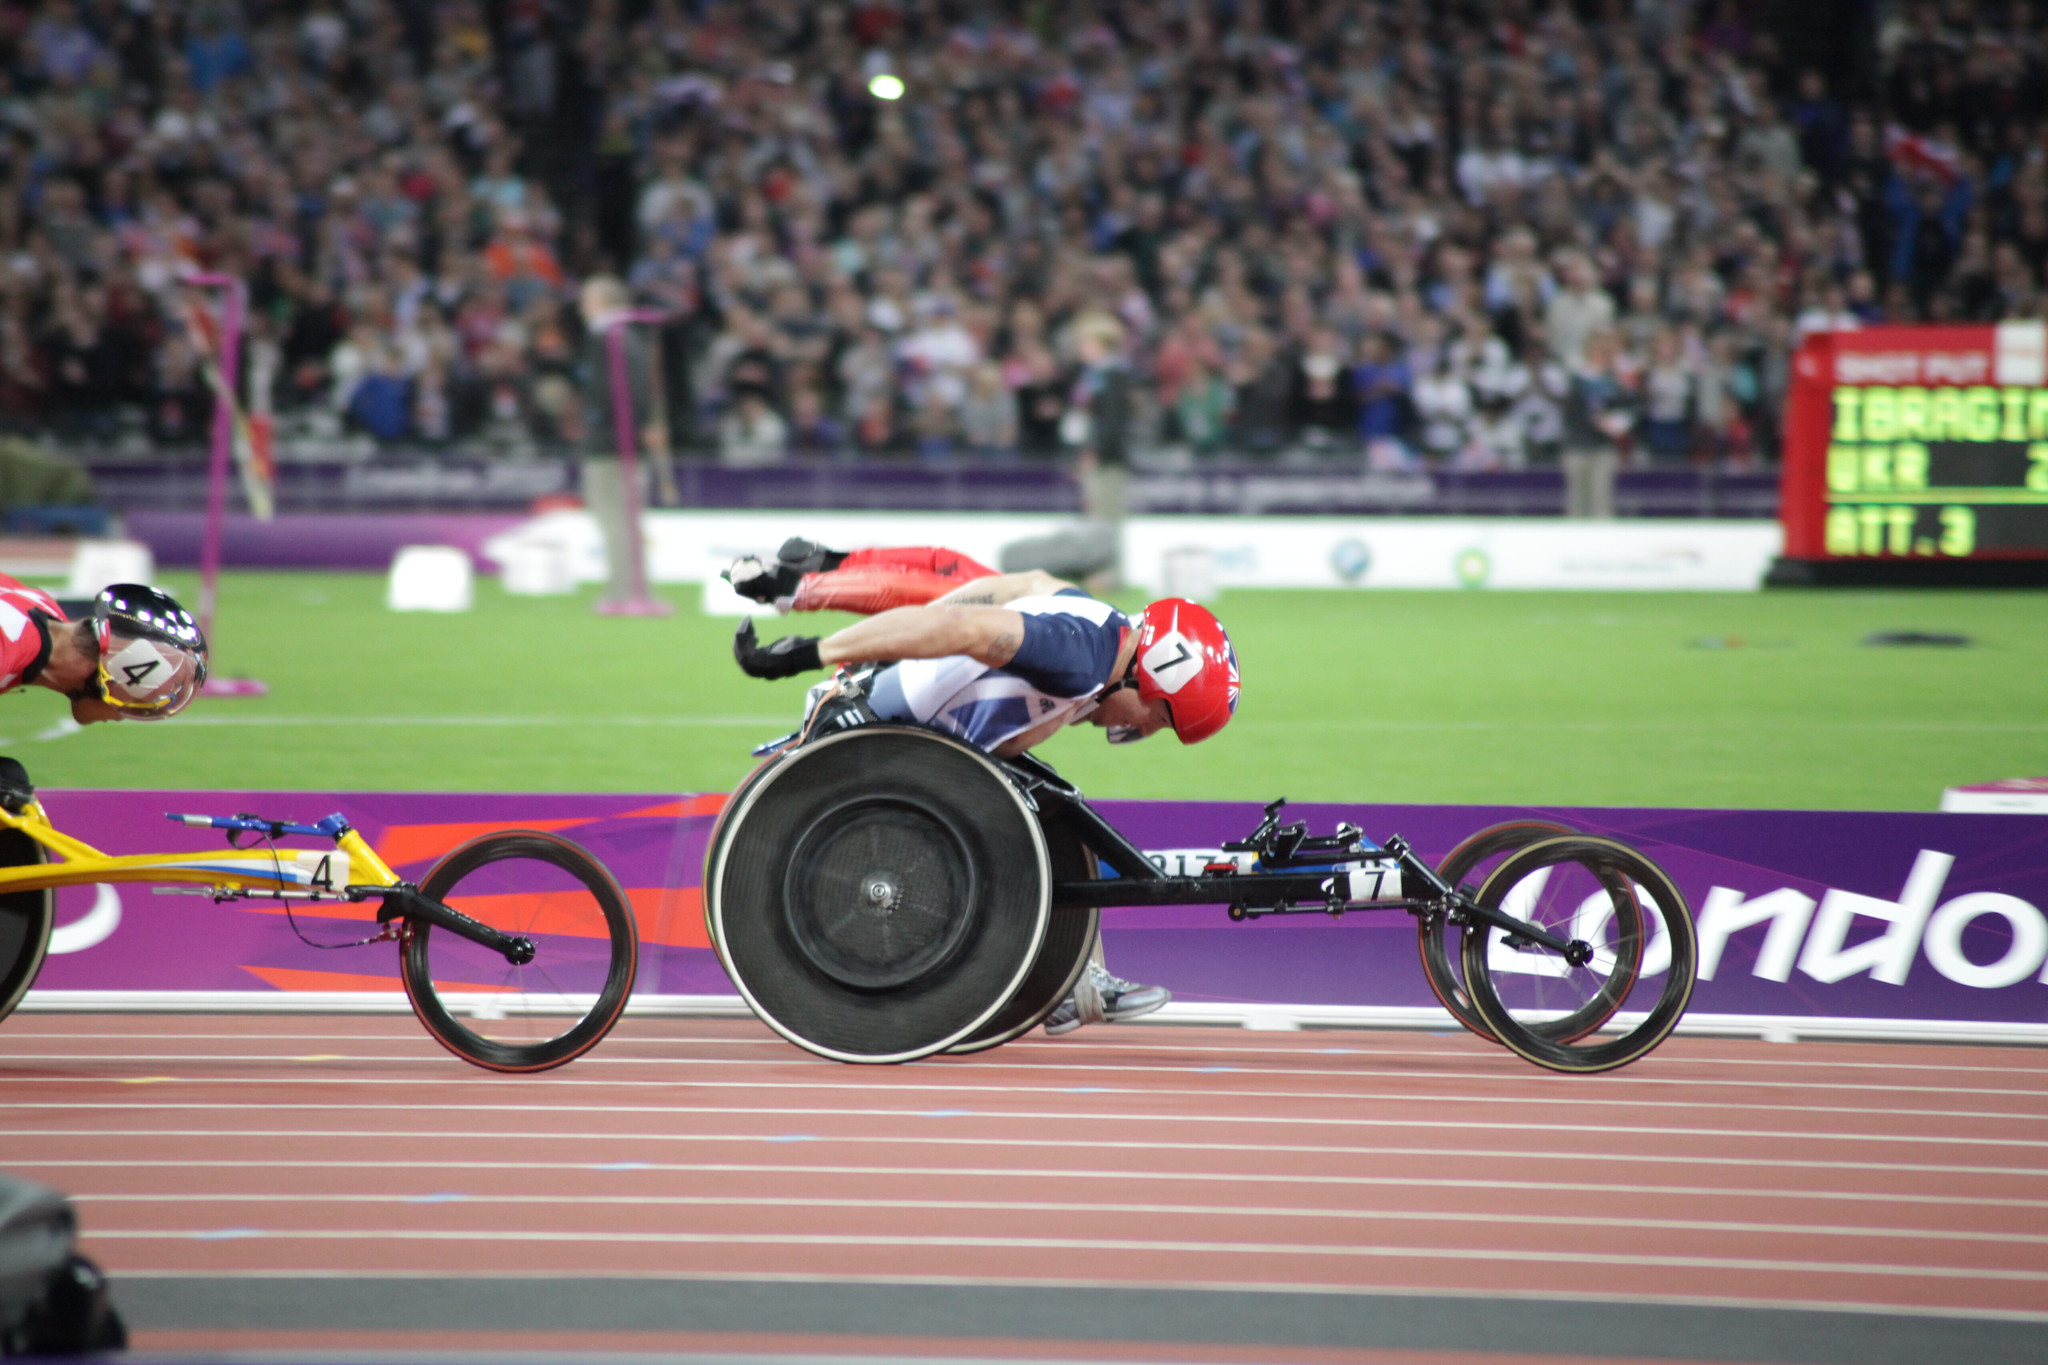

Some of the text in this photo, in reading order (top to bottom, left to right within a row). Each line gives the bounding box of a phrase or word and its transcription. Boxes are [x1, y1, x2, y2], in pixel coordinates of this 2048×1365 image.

[122, 660, 160, 687] 4
[1153, 642, 1192, 674] 7
[311, 854, 335, 892] 4
[1365, 871, 1387, 900] 7
[1487, 849, 2048, 989] Londo
